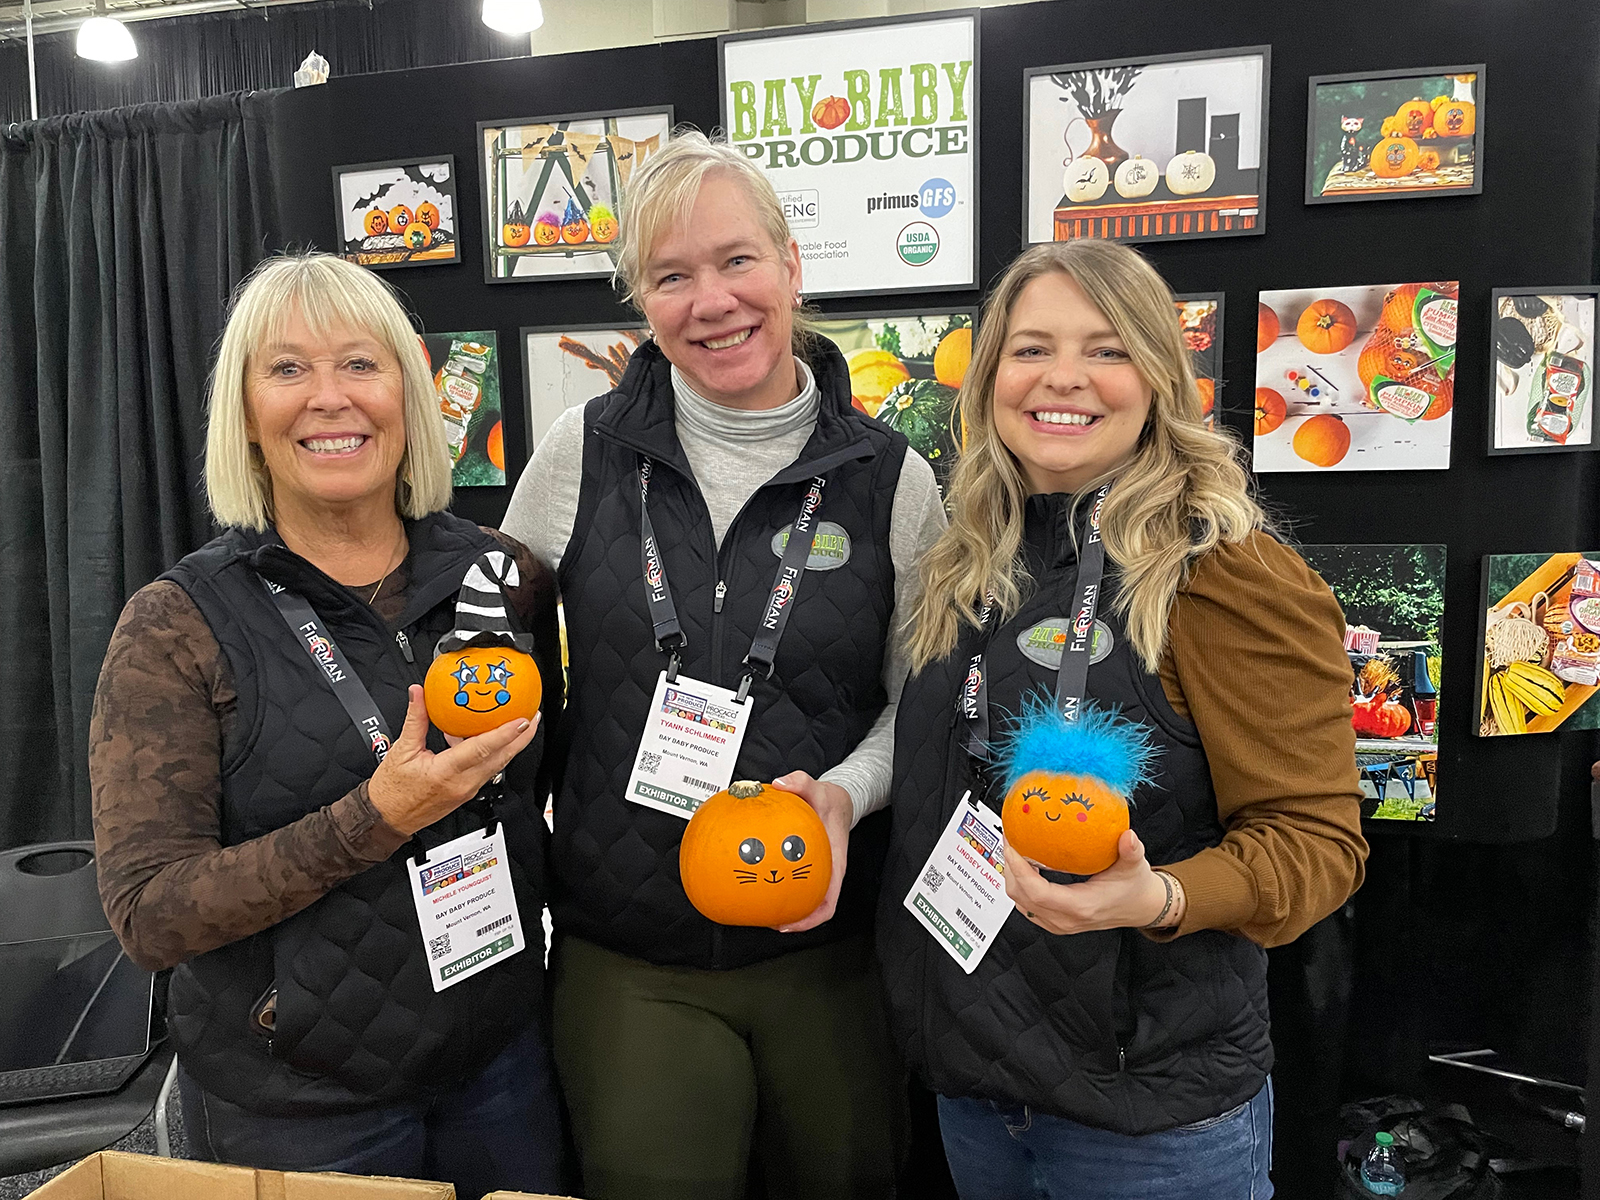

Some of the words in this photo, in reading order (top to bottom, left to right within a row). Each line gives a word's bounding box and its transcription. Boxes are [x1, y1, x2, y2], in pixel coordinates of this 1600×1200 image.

[730, 74, 822, 142] BAY
[843, 60, 973, 133] BABY
[738, 125, 968, 169] PRODUCE
[784, 203, 816, 217] ENC
[867, 192, 919, 214] primus
[922, 187, 953, 208] GFS
[824, 240, 847, 249] Food
[903, 244, 936, 256] ORGANIC
[906, 232, 930, 243] USDA
[800, 250, 849, 260] Association
[1428, 307, 1457, 322] PUMP
[798, 476, 826, 533] FIERMAN
[813, 533, 846, 551] BABY
[644, 536, 666, 603] FIERMAN
[765, 565, 799, 630] FIERMAN
[1070, 585, 1096, 652] FIERMAN
[299, 621, 346, 683] FIERMAN
[964, 654, 982, 719] FIERMAN
[677, 697, 703, 709] PRODUCE
[658, 733, 671, 743] BAY
[672, 737, 689, 748] BABY
[690, 742, 719, 757] PRODUCE
[660, 719, 684, 731] TYANN
[684, 727, 726, 745] SCHLIMMER
[662, 749, 679, 758] Mount
[638, 785, 688, 808] EXHIBITOR
[433, 861, 460, 876] PRODUCE
[947, 854, 958, 866] BAY
[957, 864, 971, 880] BABY
[971, 878, 995, 904] PRODUCE
[956, 844, 981, 870] LINDSEY
[980, 867, 1001, 890] LANCE
[432, 890, 457, 905] MICHELE
[457, 873, 493, 893] YOUNGQUIST
[946, 871, 959, 887] Mount
[973, 899, 982, 910] WA
[435, 910, 448, 920] BAY
[449, 902, 466, 914] BABY
[466, 888, 496, 905] PRODUCE
[445, 919, 462, 929] Mount
[482, 904, 491, 912] WA
[916, 899, 955, 941] EXHIBITOR
[444, 947, 493, 976] EXHIBITOR
